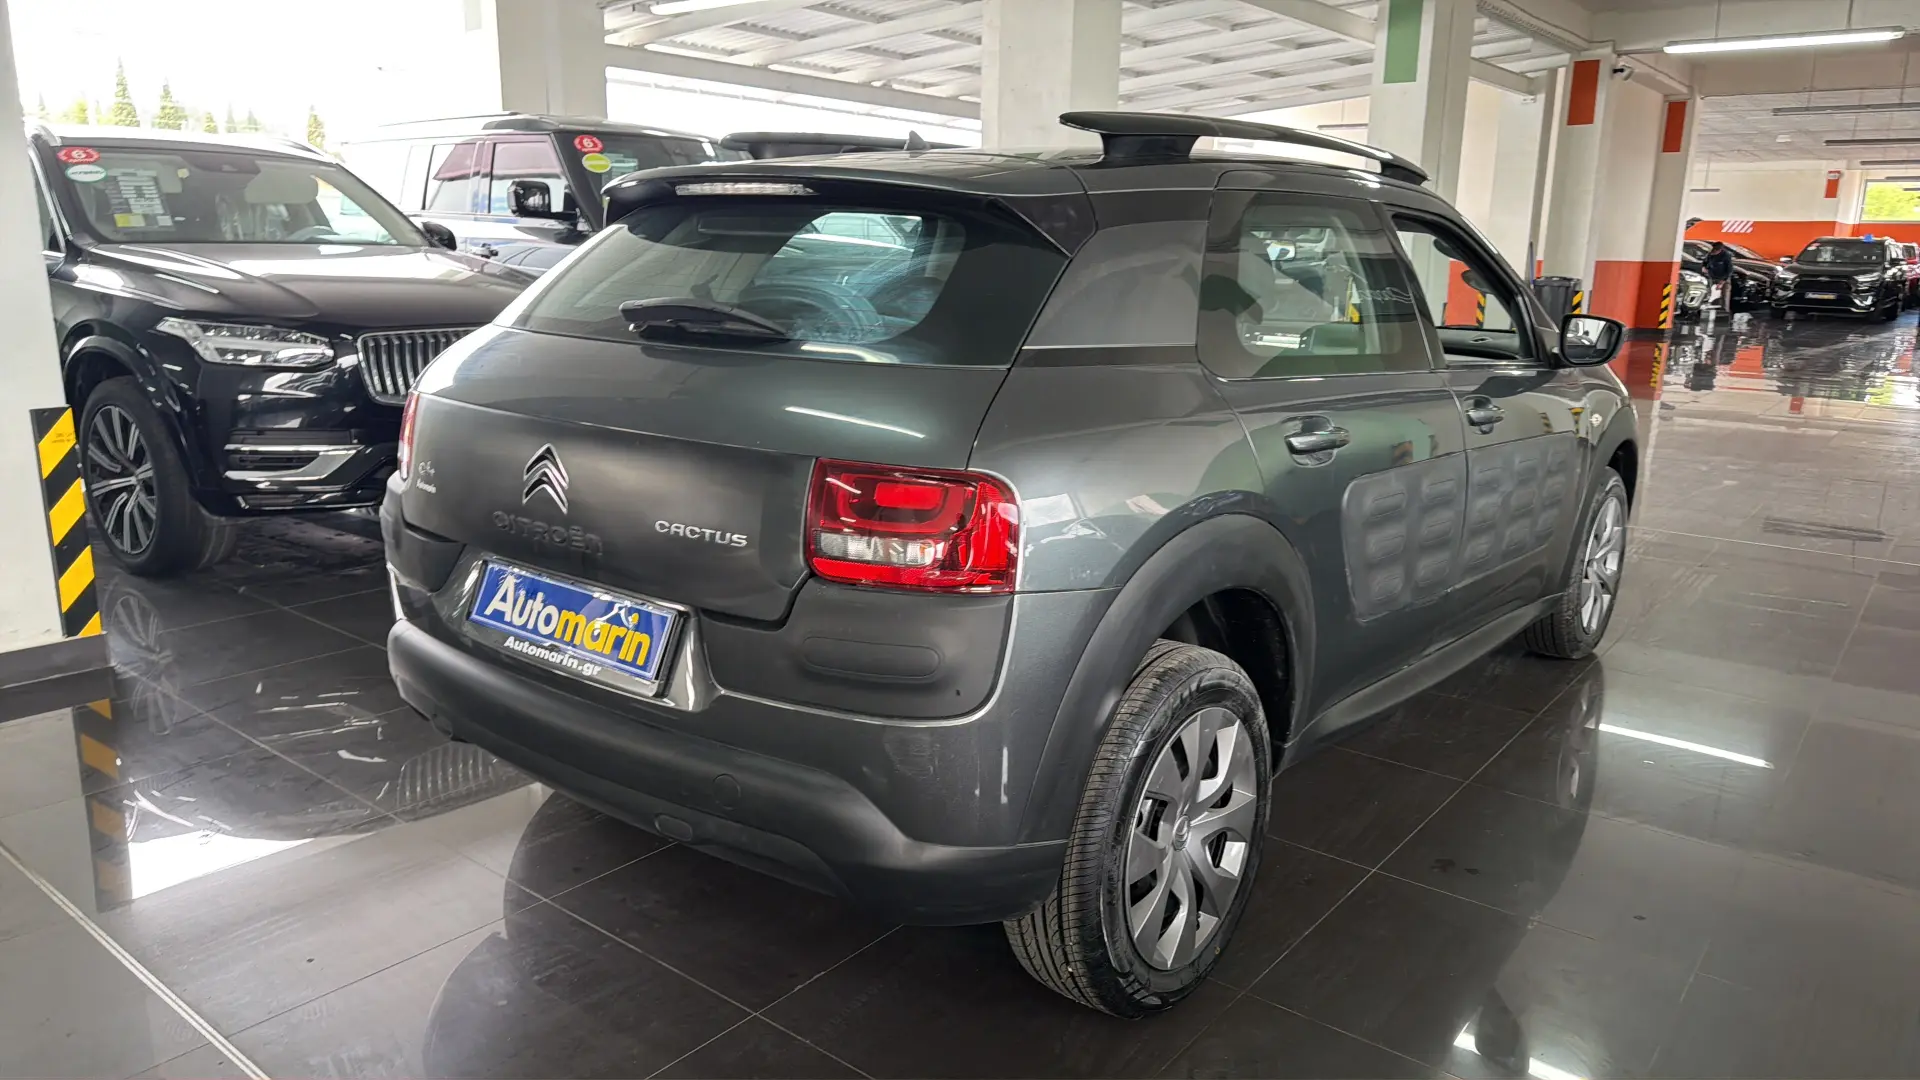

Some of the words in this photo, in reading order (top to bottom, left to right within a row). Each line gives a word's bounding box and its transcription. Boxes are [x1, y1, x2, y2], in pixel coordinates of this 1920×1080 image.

[654, 520, 748, 547] CACTUS
[484, 574, 651, 667] Automarin
[503, 635, 602, 676] Automarin.gr
